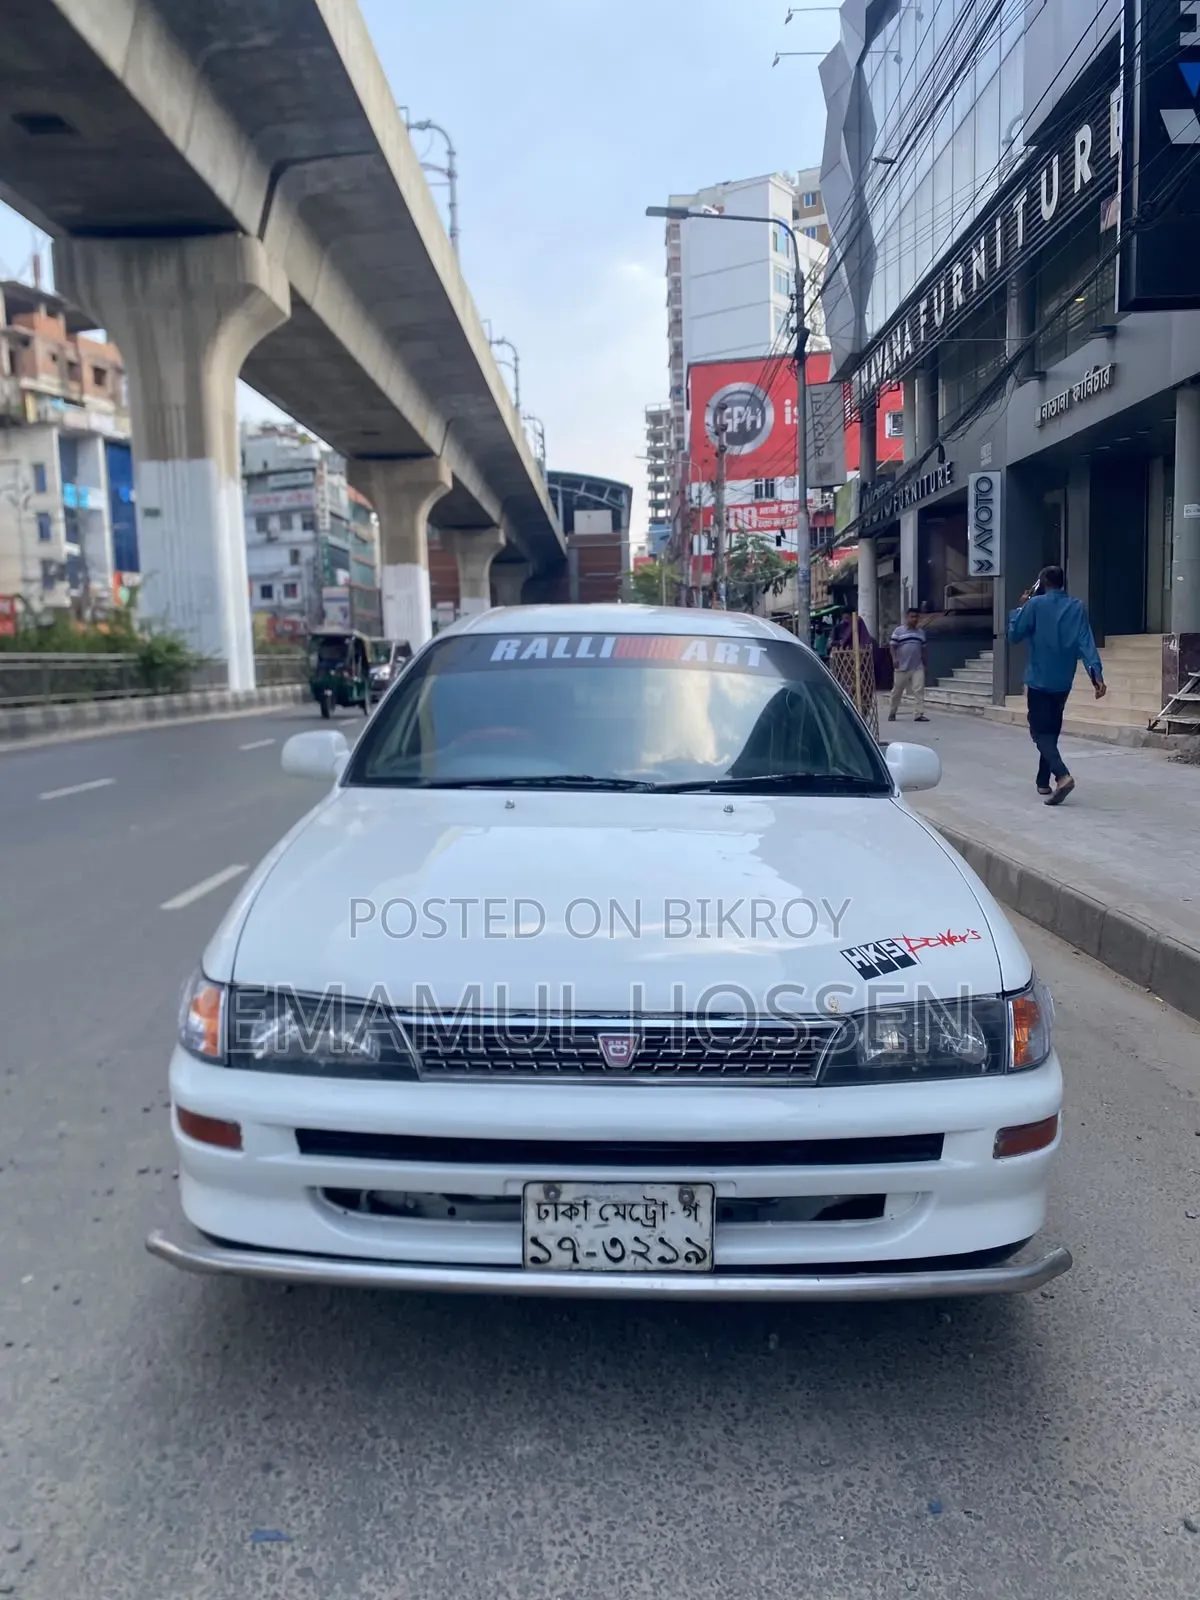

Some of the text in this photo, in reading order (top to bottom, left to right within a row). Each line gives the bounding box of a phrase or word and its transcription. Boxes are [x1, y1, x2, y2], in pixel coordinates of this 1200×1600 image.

[861, 319, 913, 400] NAVANA
[893, 460, 952, 513] FURNITURE
[974, 475, 993, 557] AYOTO
[841, 940, 907, 970] HKS
[536, 1200, 592, 1222] ঢাকা
[529, 1235, 708, 1265] ১৭-৩২১৯
